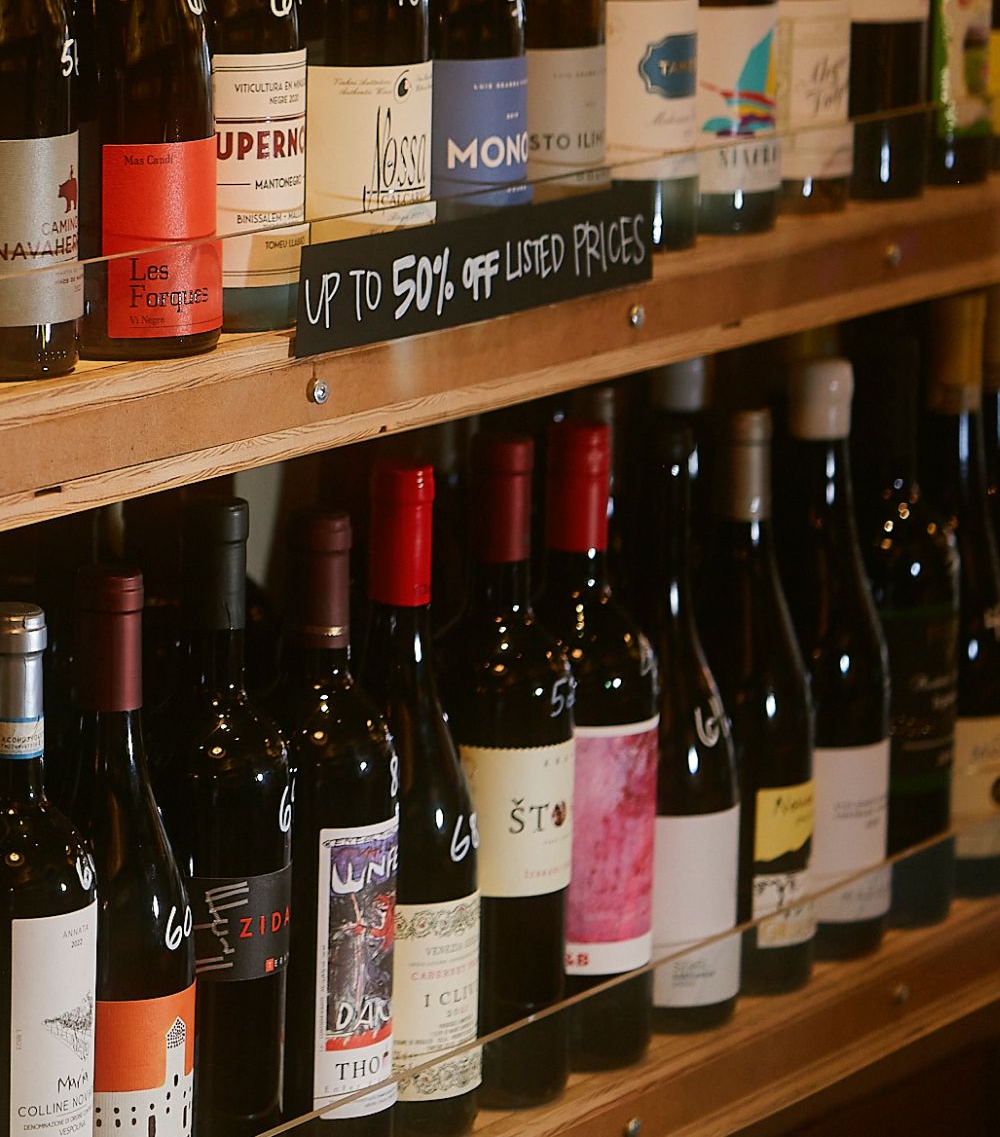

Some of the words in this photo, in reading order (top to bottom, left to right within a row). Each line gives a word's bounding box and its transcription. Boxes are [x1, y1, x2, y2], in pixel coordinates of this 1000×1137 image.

[129, 257, 170, 281] Les
[305, 272, 341, 329] UP
[349, 269, 383, 322] TO
[393, 246, 455, 321] 50%
[462, 249, 500, 302] OFF
[506, 233, 565, 282] LISTED
[573, 213, 646, 278] PRICES
[17, 1099, 69, 1118] COLLINE
